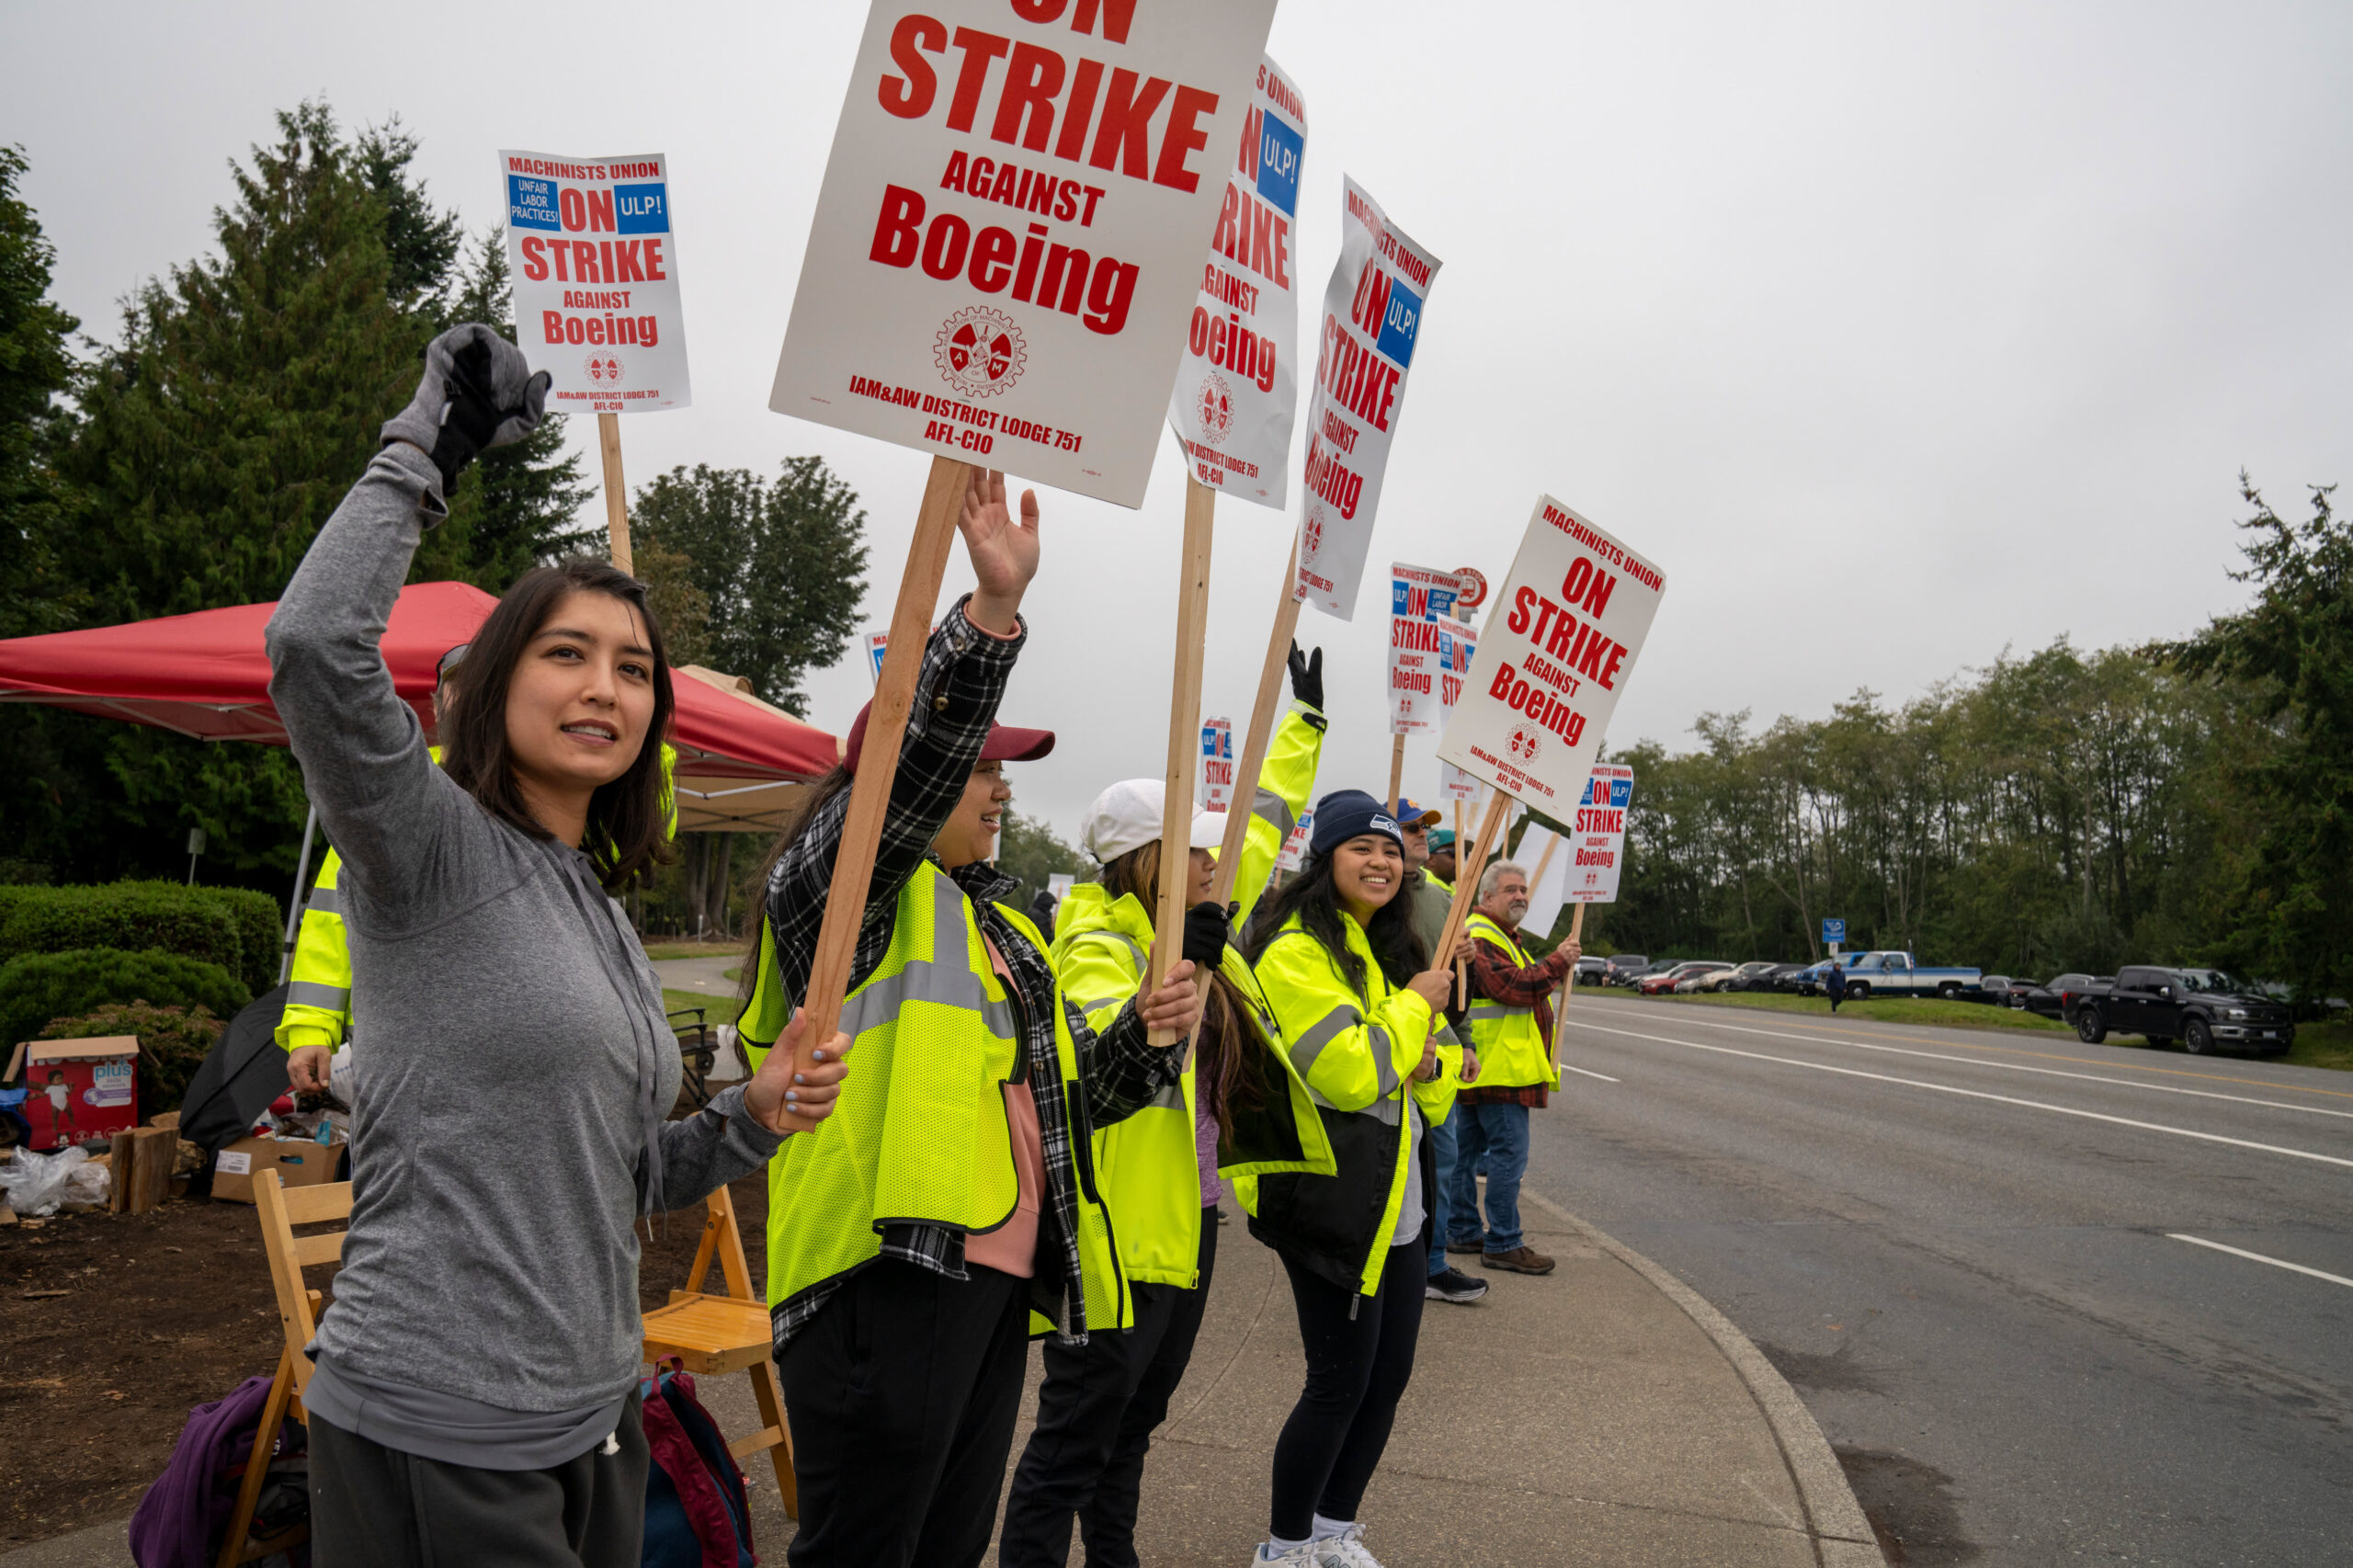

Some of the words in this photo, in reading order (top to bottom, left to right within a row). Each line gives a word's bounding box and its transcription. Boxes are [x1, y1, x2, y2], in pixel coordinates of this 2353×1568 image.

[878, 14, 1219, 194] STRIKE
[1267, 72, 1303, 123] UNION
[1238, 102, 1263, 183] N
[1264, 134, 1296, 184] ULP!
[508, 157, 606, 180] MACHINISTS
[610, 162, 659, 179] UNION
[518, 180, 549, 195] UNFAIR
[521, 193, 548, 208] LABOR
[940, 150, 1105, 227] AGAINST
[511, 206, 559, 223] PRACTICES!
[559, 188, 616, 232] ON
[620, 196, 662, 216] ULP!
[1211, 181, 1289, 291] RIKE
[1348, 188, 1397, 261] MACHINISTS
[1396, 244, 1431, 287] UNION
[521, 236, 666, 284] STRIKE
[869, 184, 1140, 335] Boeing
[564, 291, 631, 309] AGAINST
[1351, 257, 1392, 341] ON
[543, 310, 658, 347] Boeing
[1389, 297, 1416, 340] ULP!
[954, 352, 962, 362] A
[1189, 305, 1276, 393] oeing
[992, 362, 1003, 373] M
[1319, 313, 1400, 434] STRIKE
[557, 392, 587, 400] IAM&AW
[623, 390, 646, 399] LODGE
[594, 402, 623, 410] AFL-CIO
[849, 375, 921, 410] IAM&AW
[921, 392, 1000, 431] DISTRICT
[1000, 412, 1052, 448] LODGE
[1053, 428, 1082, 454] 751
[1322, 407, 1359, 455] AGAINST
[924, 420, 994, 455] AFL-CIO
[1195, 443, 1225, 467] DISTRICT
[1225, 455, 1246, 475] LODGE
[1247, 463, 1258, 479] 751
[1197, 463, 1223, 485] AFL-CIO
[1304, 430, 1363, 520] Boeing
[1542, 504, 1624, 566] MACHINISTS
[1623, 552, 1663, 592] UNION
[1431, 574, 1461, 589] UNION
[1561, 556, 1617, 620] ON
[1408, 586, 1429, 617] ON
[1392, 618, 1440, 653] STRIKE
[1507, 585, 1628, 692] STRIKE
[1399, 654, 1424, 667] AGAINST
[1453, 641, 1466, 674] ON
[1522, 652, 1581, 698] AGAINST
[1393, 666, 1431, 695] Boeing
[1488, 661, 1587, 747] Boeing
[1470, 745, 1498, 766] IAM&AW
[1497, 760, 1526, 782] DISTRICT
[1525, 776, 1544, 792] LODGE
[1544, 785, 1555, 798] 751
[1496, 772, 1522, 792] AFL-CIO
[1612, 768, 1631, 778] UNION
[1593, 781, 1611, 805] ON
[1612, 786, 1628, 797] ULP!
[1576, 808, 1623, 833] STRIKE
[1576, 848, 1614, 868] Boeing
[1586, 837, 1609, 847] AGAINST
[95, 1062, 132, 1081] plus
